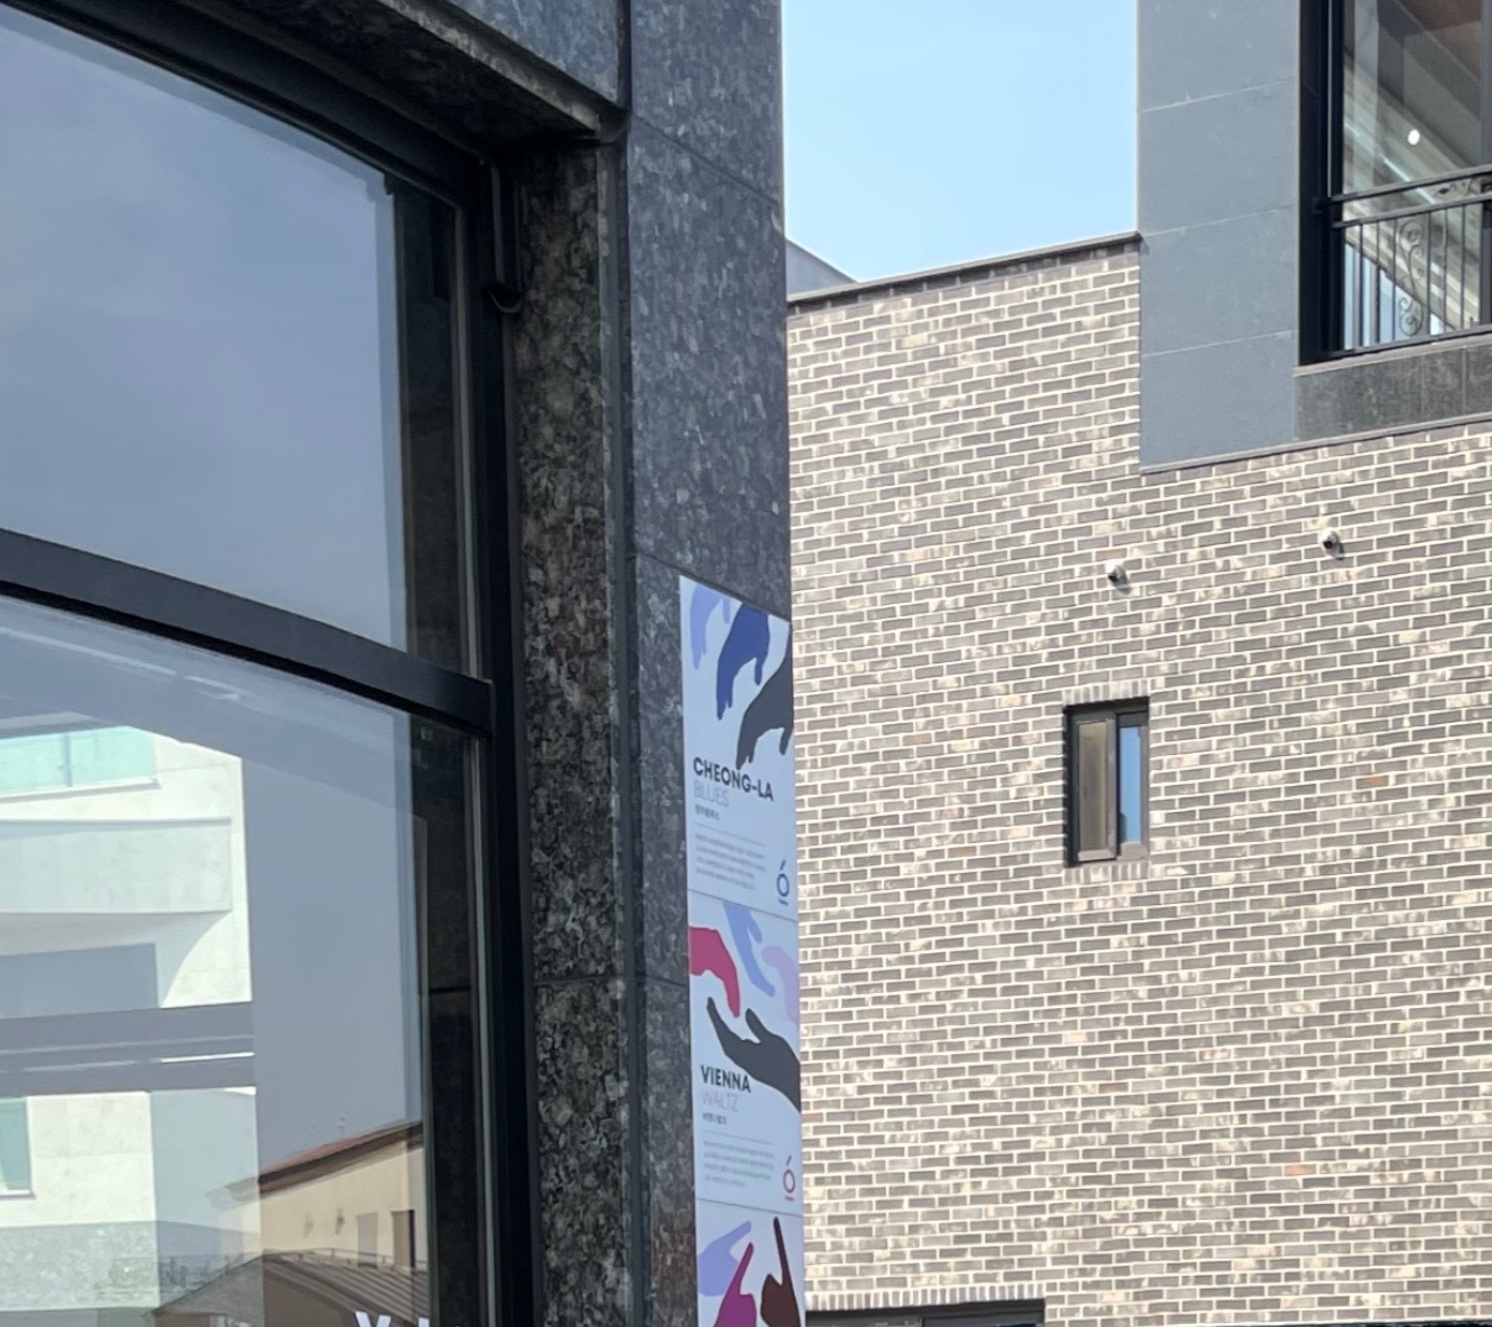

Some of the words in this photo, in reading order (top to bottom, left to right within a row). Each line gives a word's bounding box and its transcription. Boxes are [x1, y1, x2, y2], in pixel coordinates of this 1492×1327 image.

[693, 757, 774, 802] CHEONG-LA
[694, 780, 730, 808] BLUES
[701, 1064, 751, 1093] VIENNA
[701, 1089, 739, 1112] WALTZ
